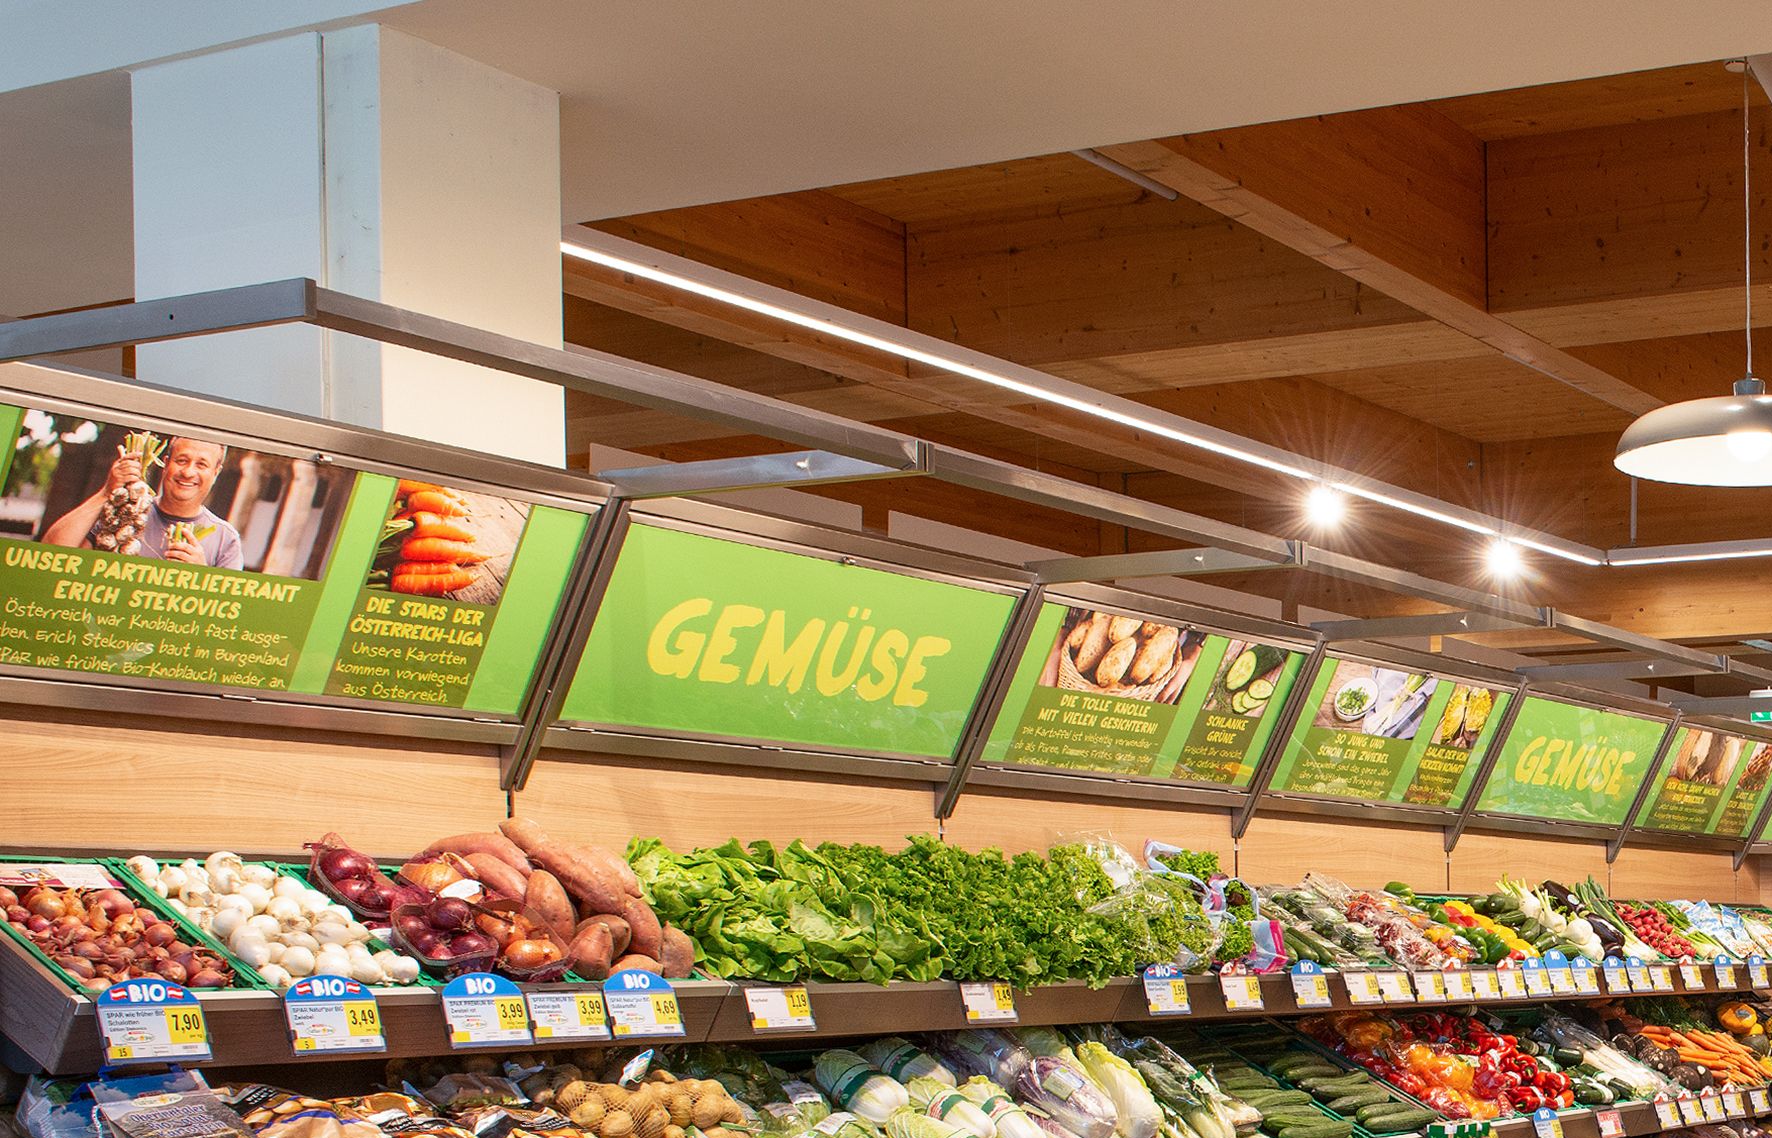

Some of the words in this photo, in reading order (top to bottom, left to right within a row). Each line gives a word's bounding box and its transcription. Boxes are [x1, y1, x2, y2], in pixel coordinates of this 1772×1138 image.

[5, 547, 83, 575] UNSER
[92, 559, 301, 603] PARTNERLIEFERANT
[54, 580, 120, 605] ERICH
[128, 589, 242, 620] STEKOVICS
[366, 596, 395, 614] DIE
[400, 601, 448, 621] STARS
[452, 608, 485, 626] DER
[5, 598, 92, 624] Österreich
[97, 614, 125, 627] war
[129, 616, 200, 636] Knoblauch
[205, 624, 237, 640] fast
[241, 630, 288, 649] ausge-
[350, 614, 483, 647] ÖSTERREICH-LIGA
[0, 623, 29, 640] ben.
[36, 630, 76, 646] Erich
[82, 632, 154, 654] Stekovics
[159, 638, 190, 658] baut
[195, 645, 209, 659] im
[215, 648, 290, 668] Burgenland
[352, 642, 401, 658] Unsere
[405, 647, 467, 665] Karotten
[647, 597, 951, 707] GEMÜSE
[0, 647, 31, 664] PAR
[36, 654, 59, 666] wie
[65, 655, 117, 673] früher
[123, 661, 217, 683] Bio-Knoblauch
[222, 672, 265, 687] wieder
[336, 658, 390, 676] kommen
[396, 669, 471, 687] vorwiegend
[343, 683, 367, 696] aus
[372, 682, 448, 703] Österreich.
[1060, 694, 1079, 708] DIE
[1082, 697, 1109, 712] TOLLE
[1114, 702, 1151, 717] KNOLLE
[1038, 708, 1059, 722] MIT
[1063, 711, 1098, 728] VIELEN
[1101, 717, 1158, 734] GESICHTERN!
[1206, 715, 1248, 731] SCHLANKE
[1035, 727, 1071, 739] Kartoffel
[1207, 730, 1236, 744] GRÜNE
[1335, 734, 1346, 744] SO
[1348, 735, 1368, 747] JUNG
[1514, 736, 1636, 795] GEMÜSE
[311, 979, 345, 996] BIO
[466, 977, 496, 994] BIO
[625, 974, 650, 989] BIO
[128, 984, 166, 1002] BIO
[790, 994, 807, 1009] 1,19
[996, 988, 1011, 1002] 1,49
[501, 1003, 523, 1020] 3,99
[581, 1000, 602, 1016] 3,99
[656, 999, 675, 1016] 4,69
[172, 1014, 199, 1033] 7,90
[350, 1010, 375, 1027] 3,49
[119, 1048, 127, 1057] 15
